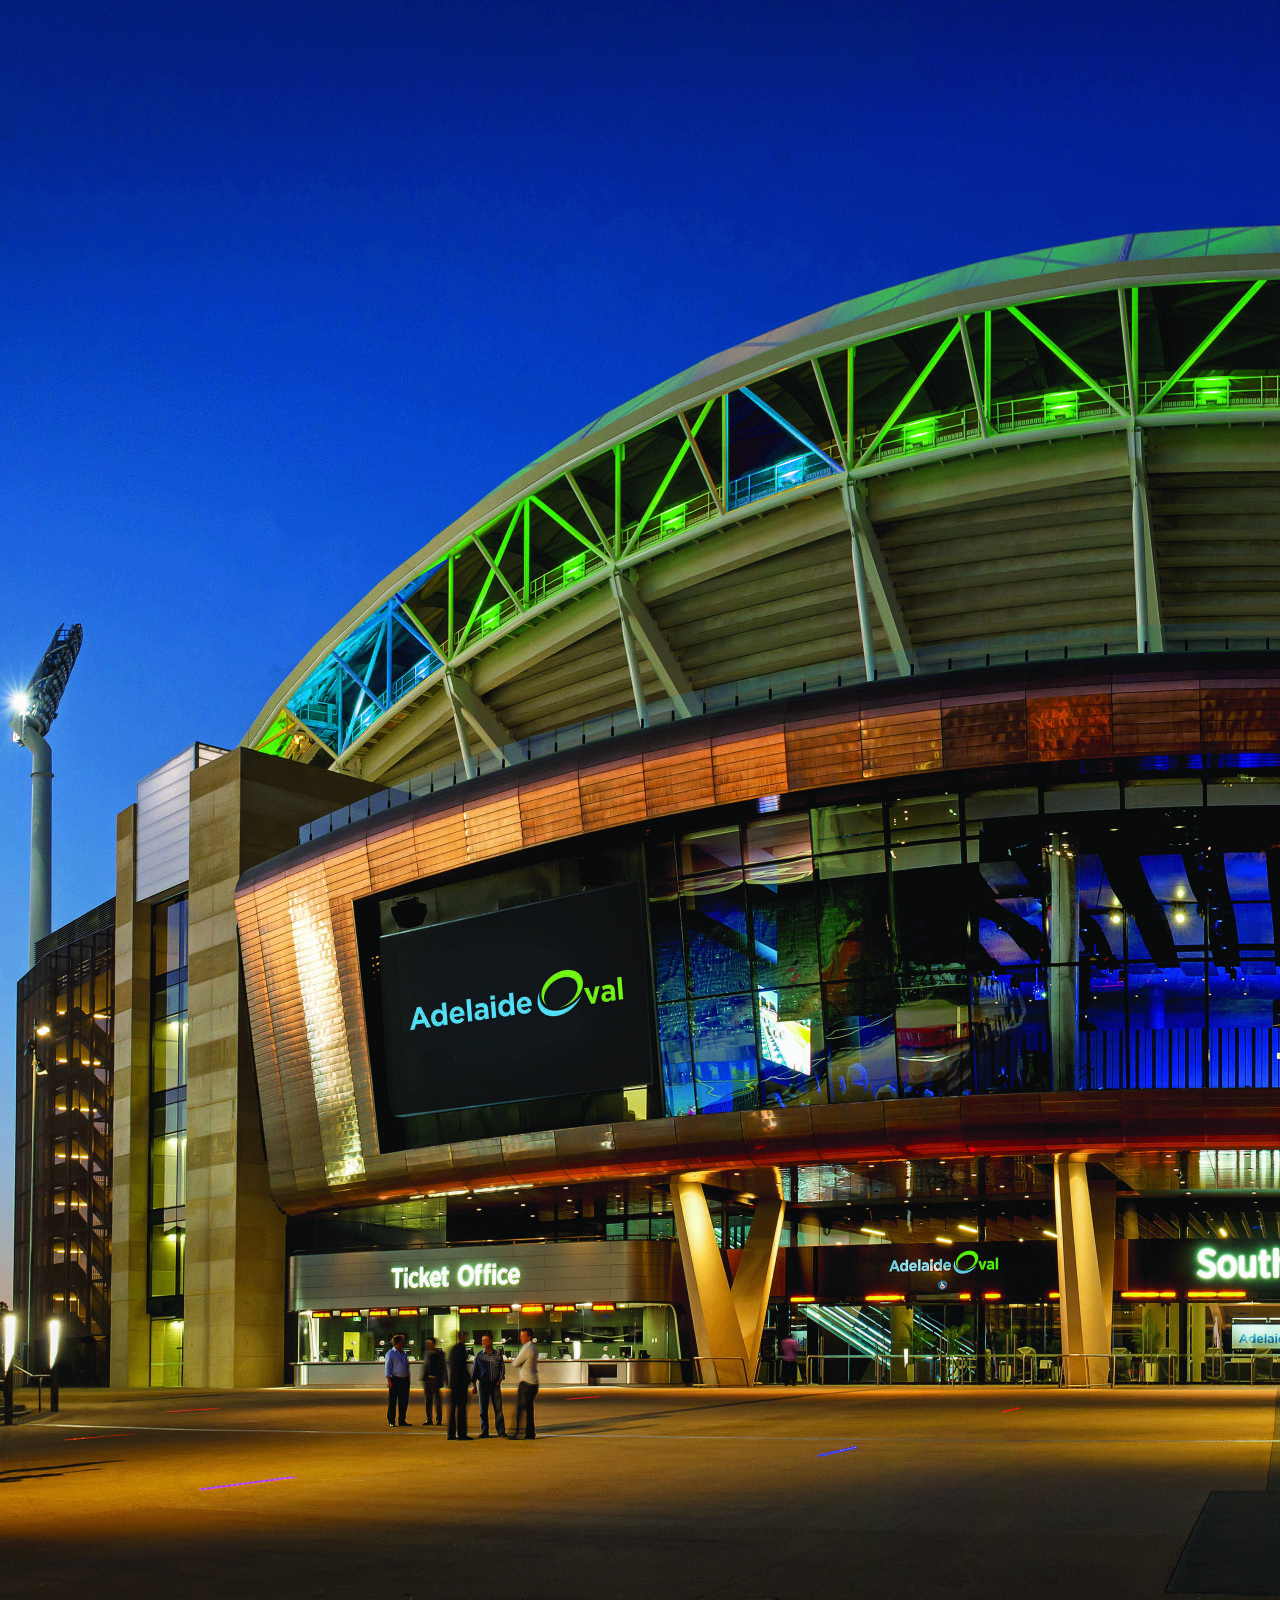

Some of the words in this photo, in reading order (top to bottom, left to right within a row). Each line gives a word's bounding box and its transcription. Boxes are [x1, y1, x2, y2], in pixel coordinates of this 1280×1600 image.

[409, 992, 533, 1031] Adelaide
[537, 969, 624, 1017] Oval
[390, 1265, 450, 1289] Ticket
[457, 1262, 521, 1287] Office
[889, 1258, 952, 1273] Adelaide
[953, 1250, 999, 1275] Oval
